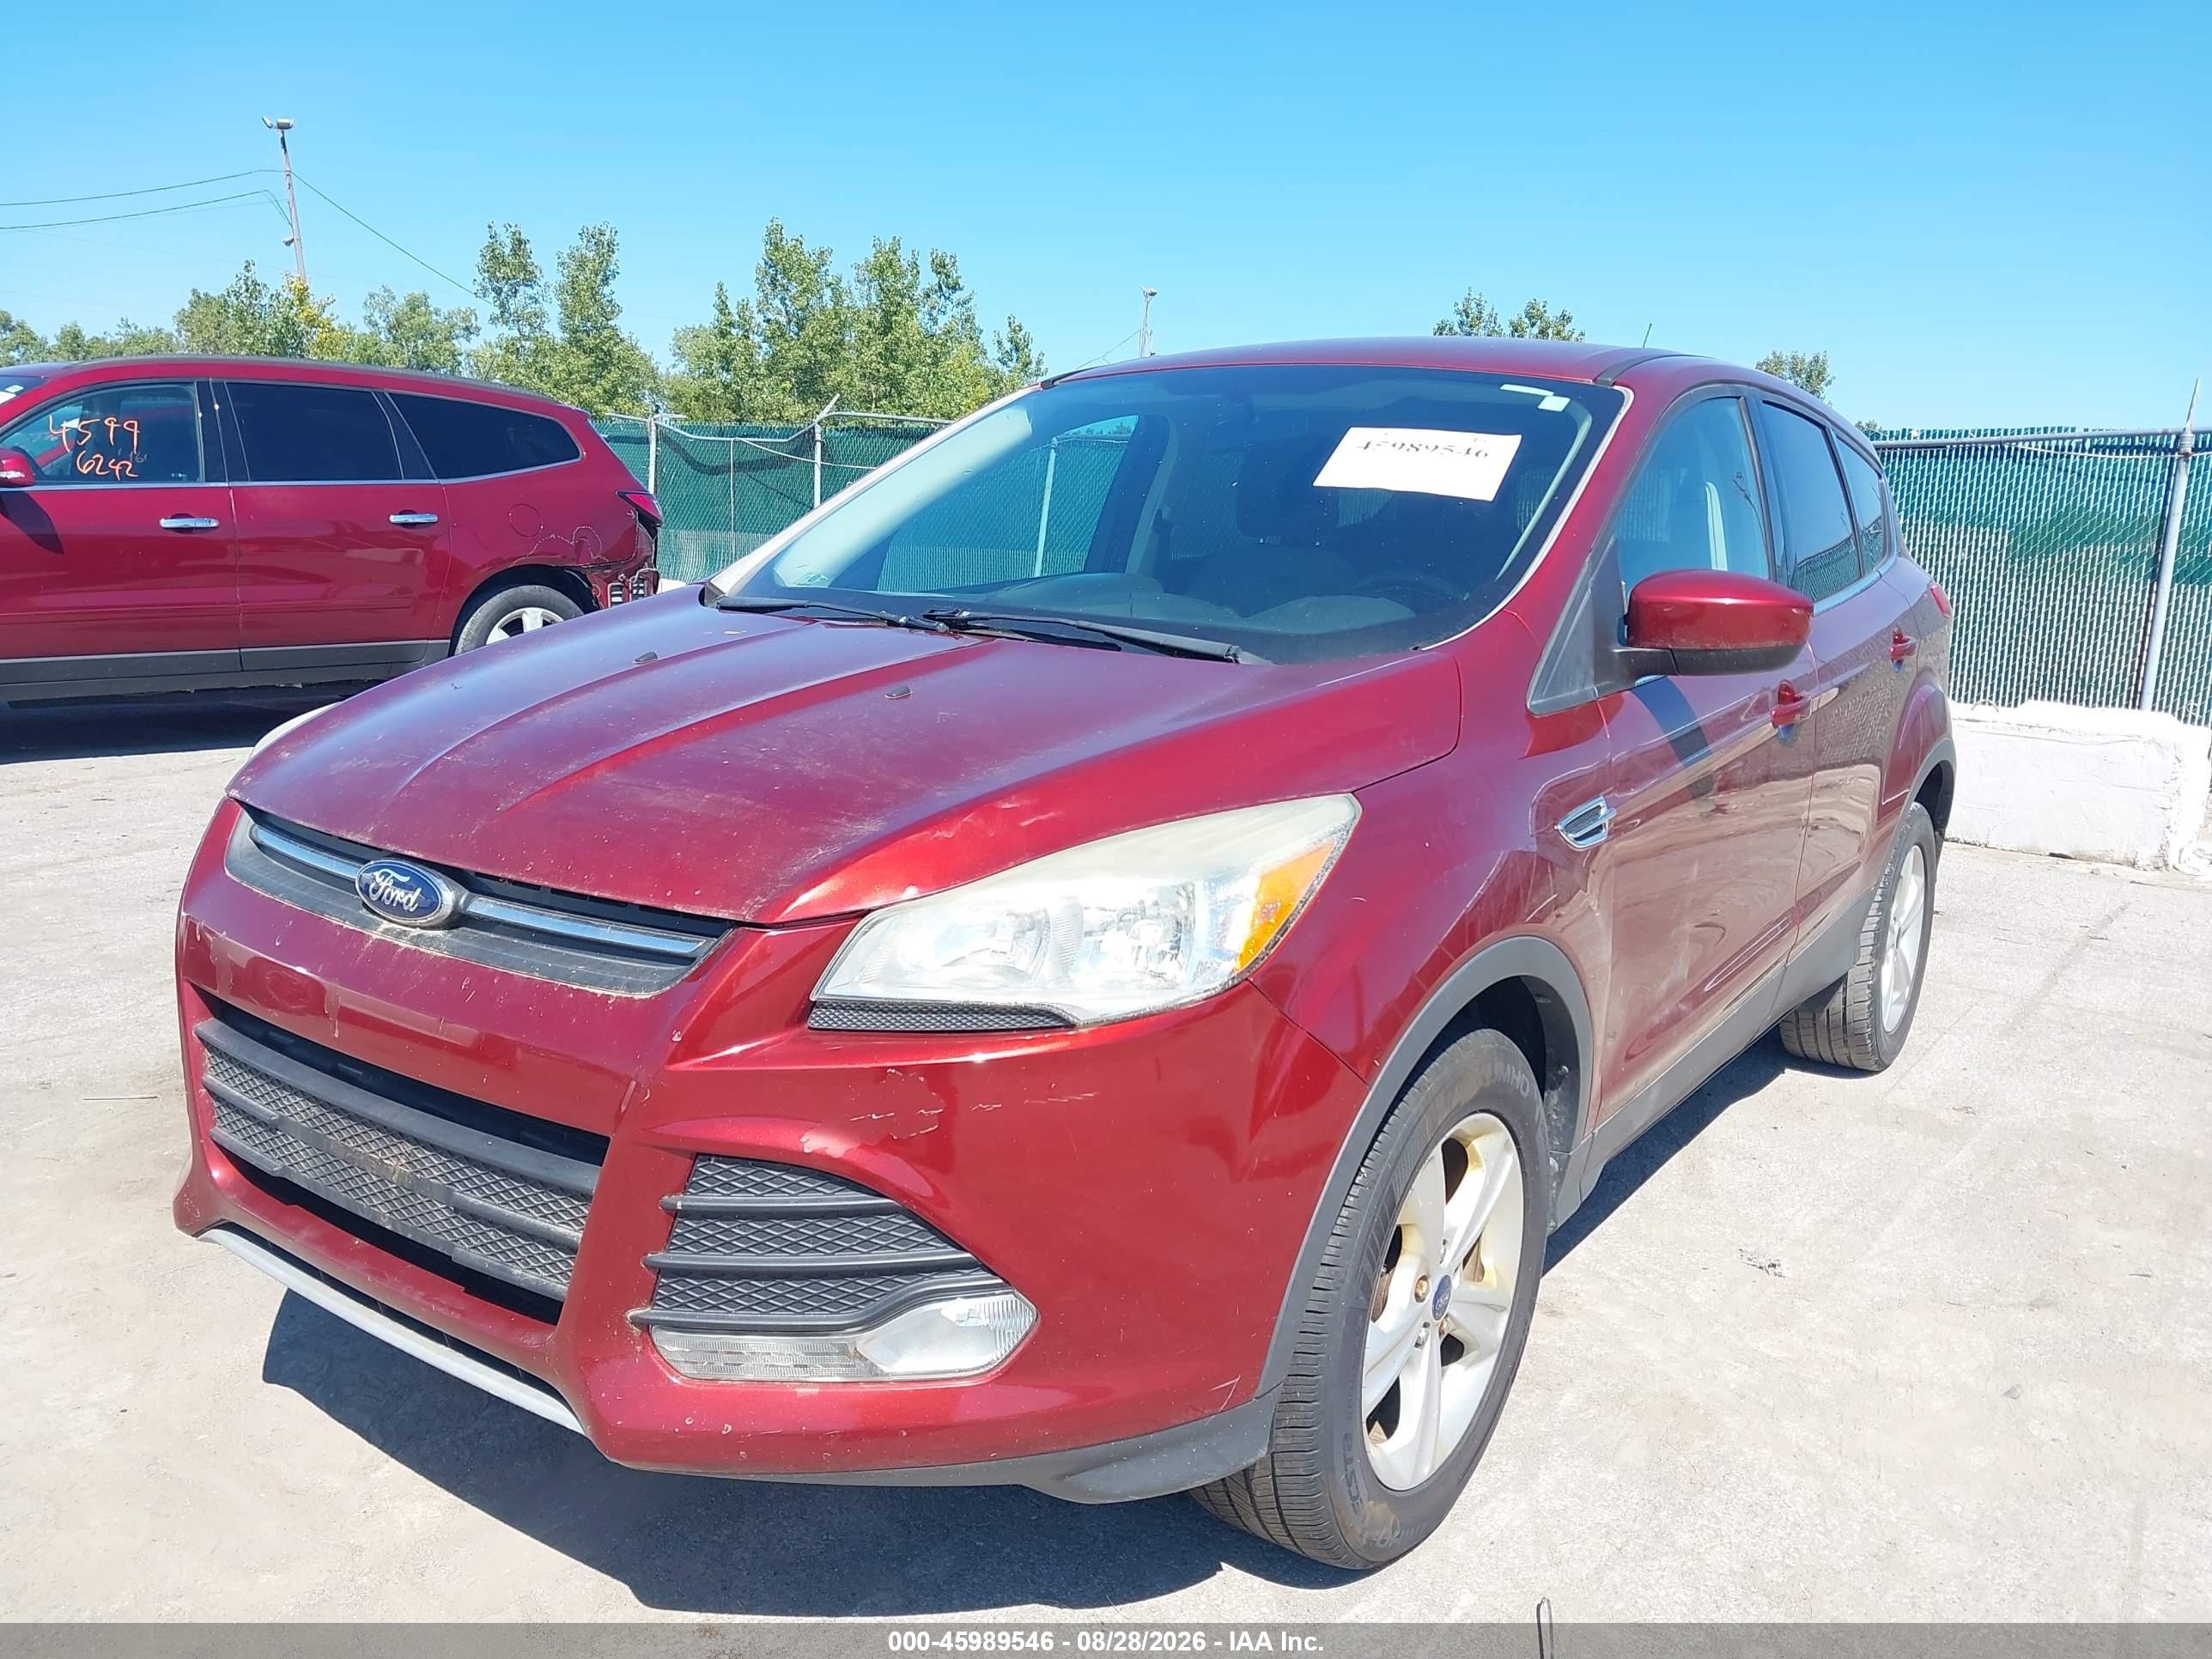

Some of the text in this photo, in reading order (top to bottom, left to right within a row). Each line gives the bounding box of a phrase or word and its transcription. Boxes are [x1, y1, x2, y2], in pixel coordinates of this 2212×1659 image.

[49, 415, 141, 454] 4599
[76, 450, 139, 481] 6242
[369, 868, 422, 912] Ford
